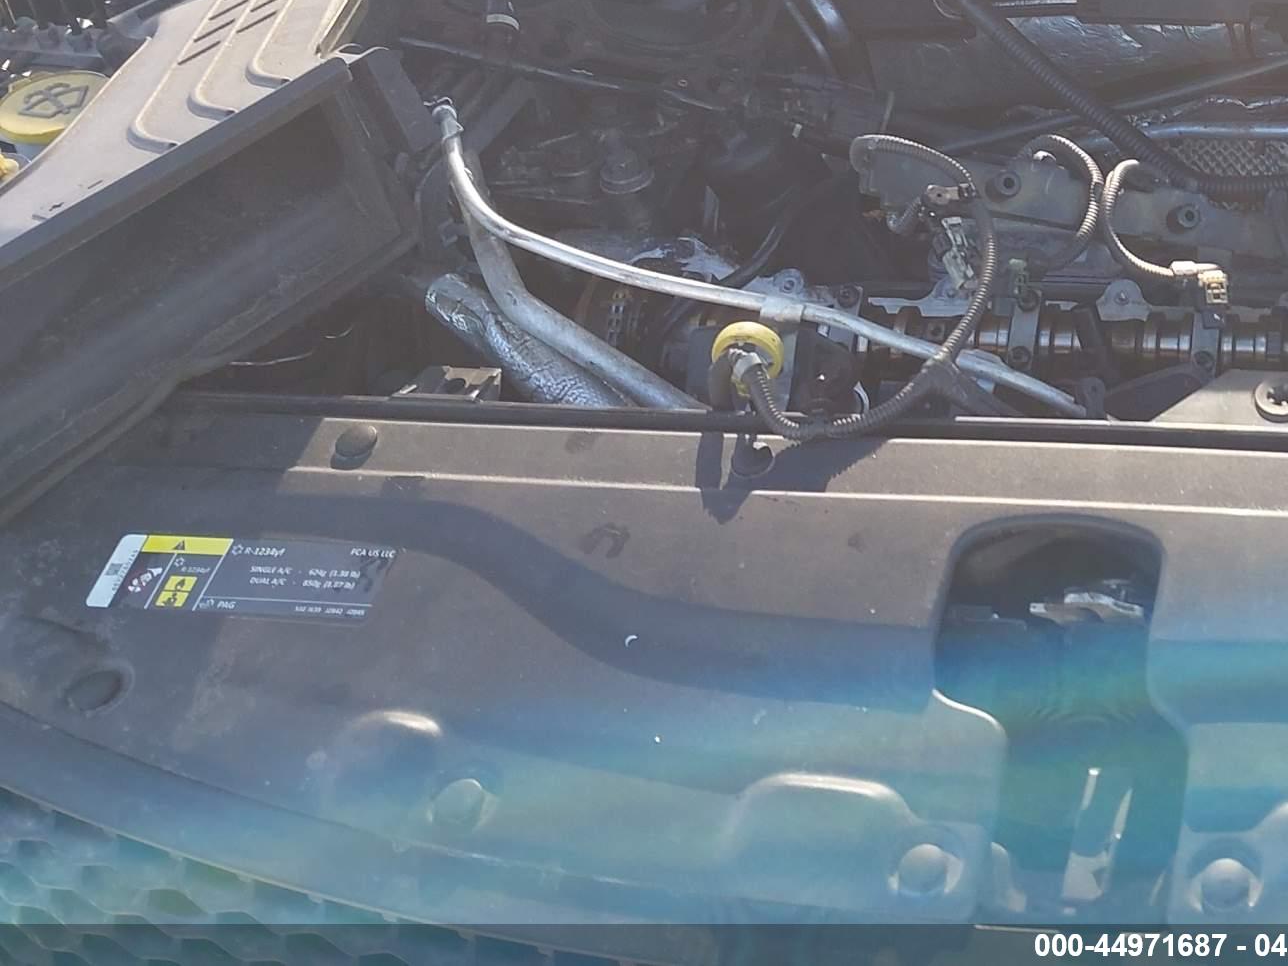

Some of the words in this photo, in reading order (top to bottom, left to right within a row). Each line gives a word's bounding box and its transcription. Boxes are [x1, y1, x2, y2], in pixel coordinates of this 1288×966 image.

[244, 547, 286, 558] R-1234yf
[351, 547, 367, 556] FCA
[380, 549, 397, 558] LLC
[250, 566, 276, 574] SINGLE
[217, 601, 236, 610] PAG
